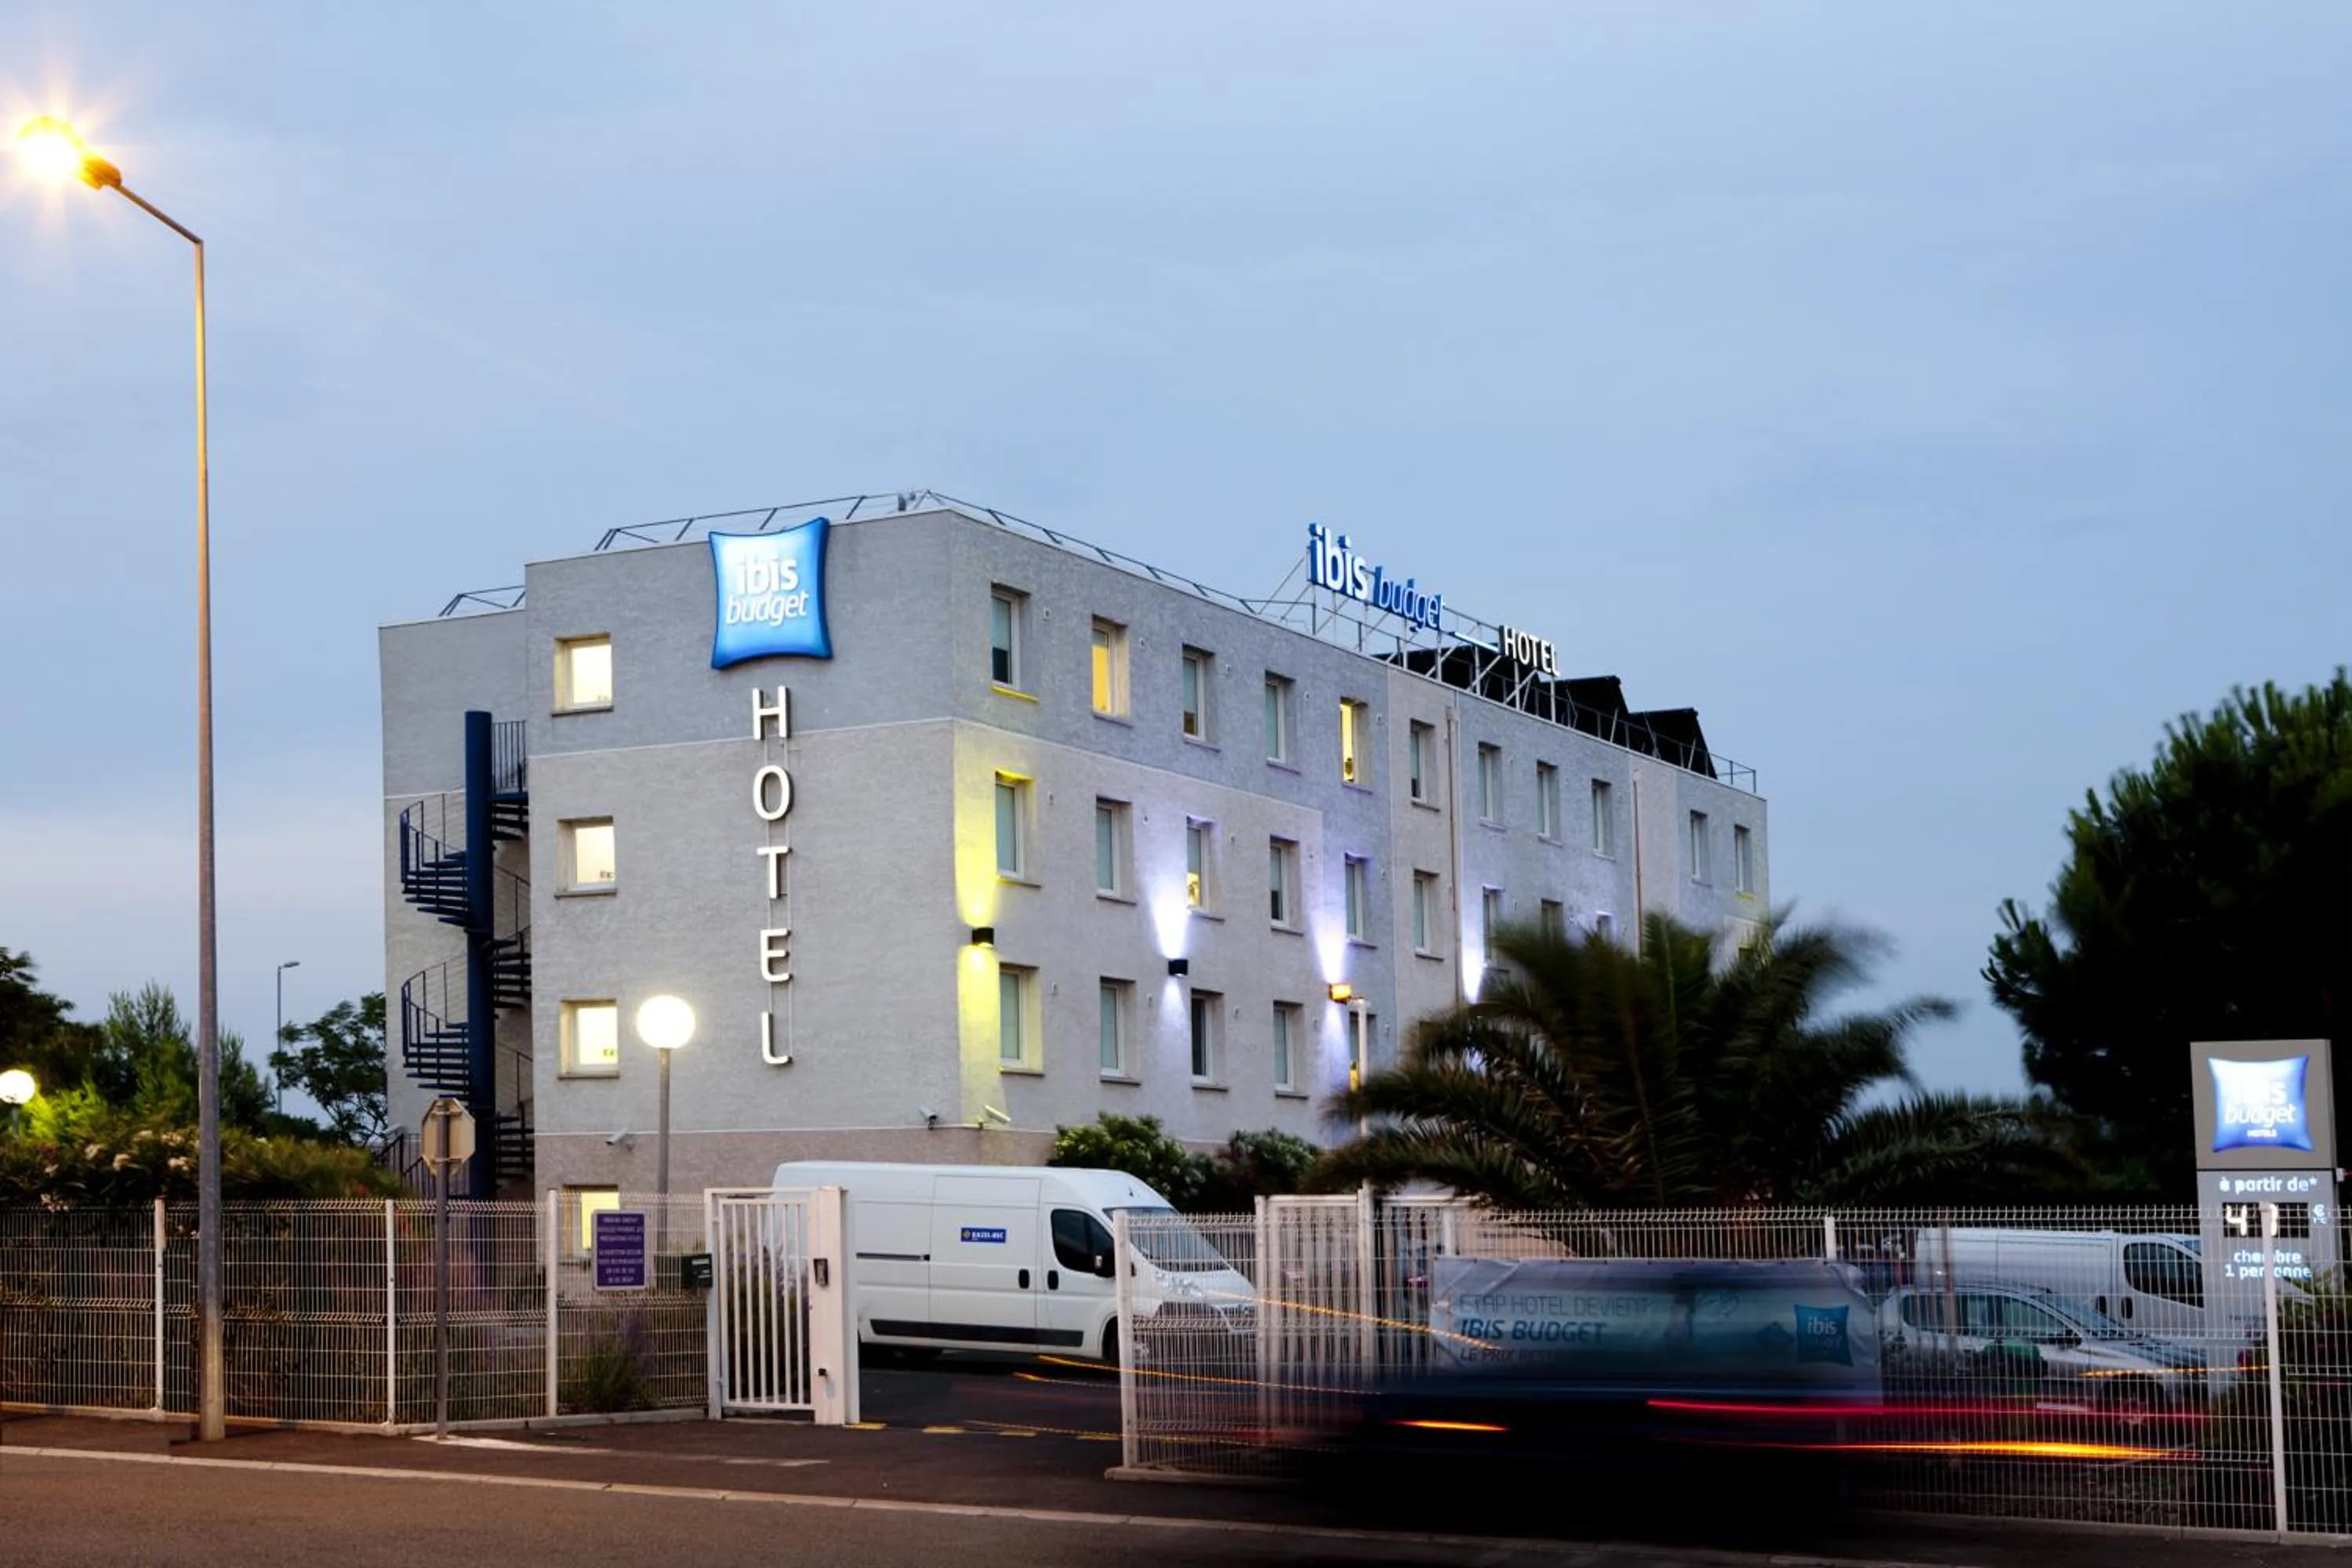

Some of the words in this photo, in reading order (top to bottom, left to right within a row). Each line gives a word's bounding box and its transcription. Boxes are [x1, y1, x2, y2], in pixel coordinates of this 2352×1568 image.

[735, 554, 798, 595] ibis
[1308, 523, 1369, 601] ibis
[1374, 565, 1446, 632] budget
[726, 590, 809, 626] budget
[1499, 625, 1560, 677] HOTEL
[752, 685, 793, 1065] HOTEL
[2225, 1103, 2296, 1127] budget
[2234, 1177, 2283, 1195] partir
[2234, 1250, 2302, 1264] chabre
[2225, 1264, 2235, 1277] 1
[2239, 1265, 2313, 1279] peronne
[1459, 1293, 1506, 1313] ETAP
[1511, 1294, 1568, 1316] HOTEL
[1460, 1318, 1506, 1340] IBIS
[1512, 1319, 1608, 1343] BUDGET
[1808, 1315, 1838, 1335] ibis
[1460, 1348, 1479, 1362] LE
[1482, 1348, 1515, 1363] PRIX
